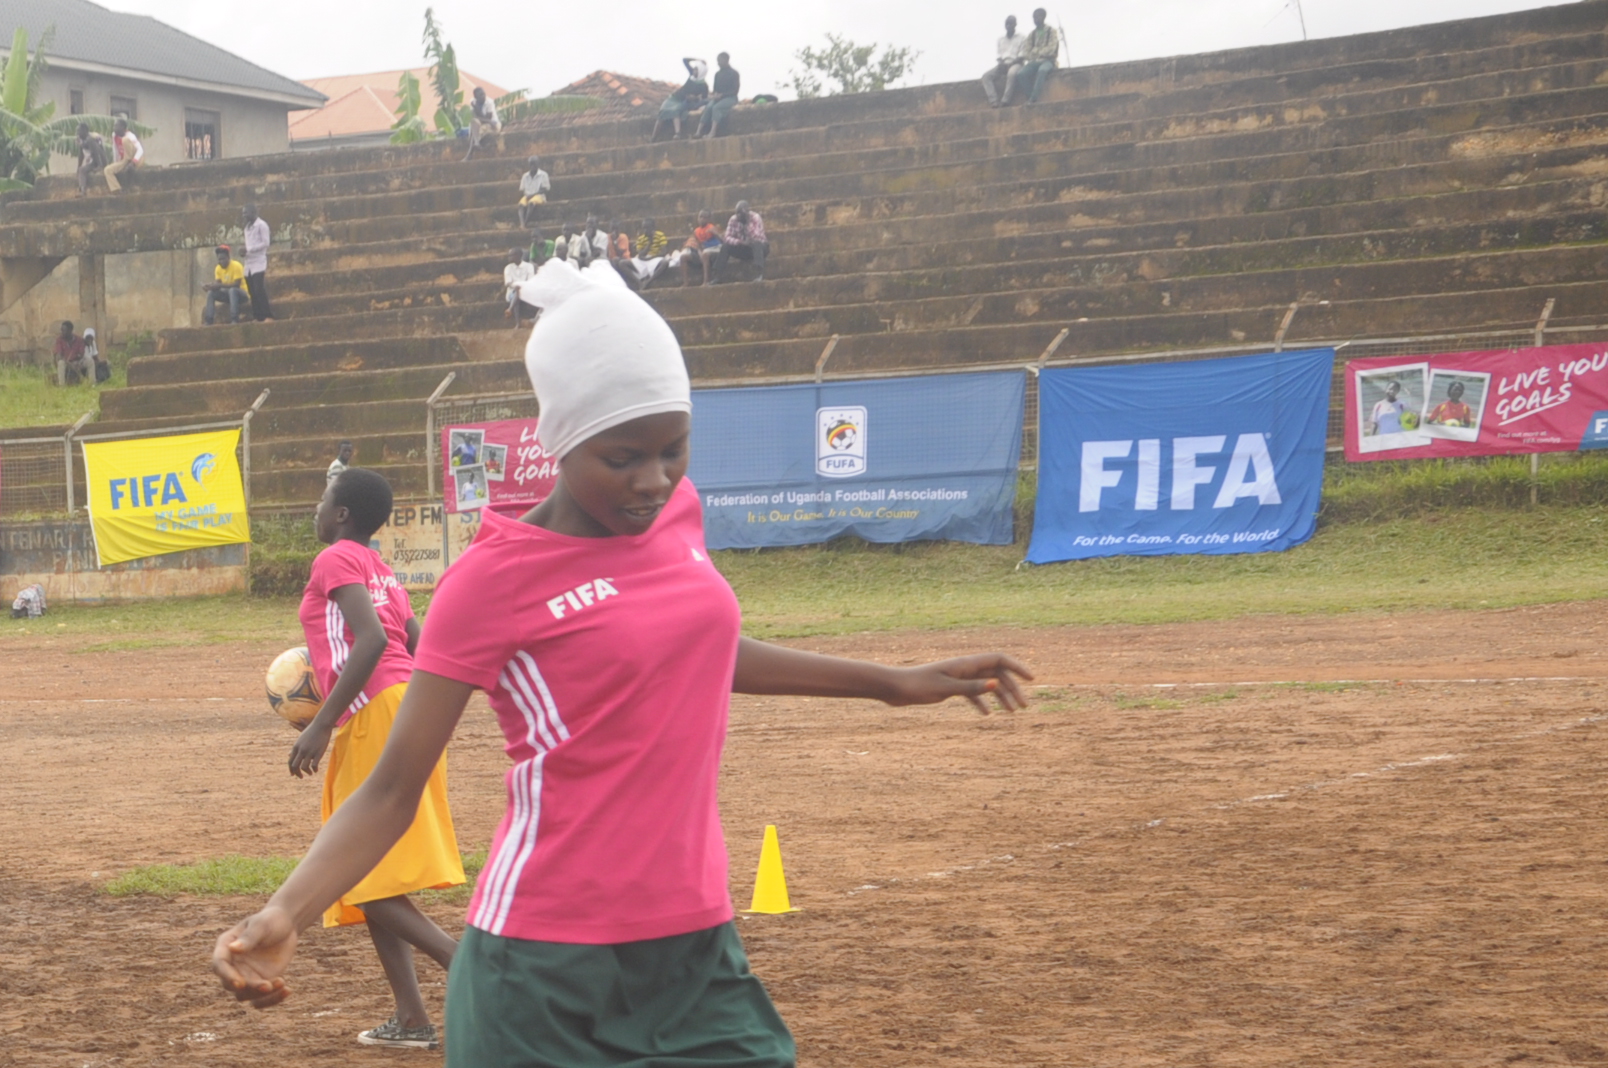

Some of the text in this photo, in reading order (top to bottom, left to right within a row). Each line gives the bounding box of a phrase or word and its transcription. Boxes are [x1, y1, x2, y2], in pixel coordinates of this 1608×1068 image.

[1497, 366, 1551, 395] LIVE
[1495, 382, 1572, 420] GOALS
[826, 459, 856, 469] FUFA
[1079, 432, 1282, 513] FIFA
[109, 472, 188, 510] FIFA
[706, 488, 968, 507] Federation of Uganda Football Associations
[178, 502, 217, 520] GAME
[203, 512, 233, 528] PLAY
[420, 506, 442, 526] FM
[769, 510, 791, 522] Our
[850, 506, 874, 519] Our
[875, 506, 920, 520] Country
[1072, 536, 1096, 547] For
[1098, 534, 1124, 546] the
[1176, 534, 1202, 544] For
[1203, 532, 1230, 544] the
[546, 578, 619, 620] FIFA
